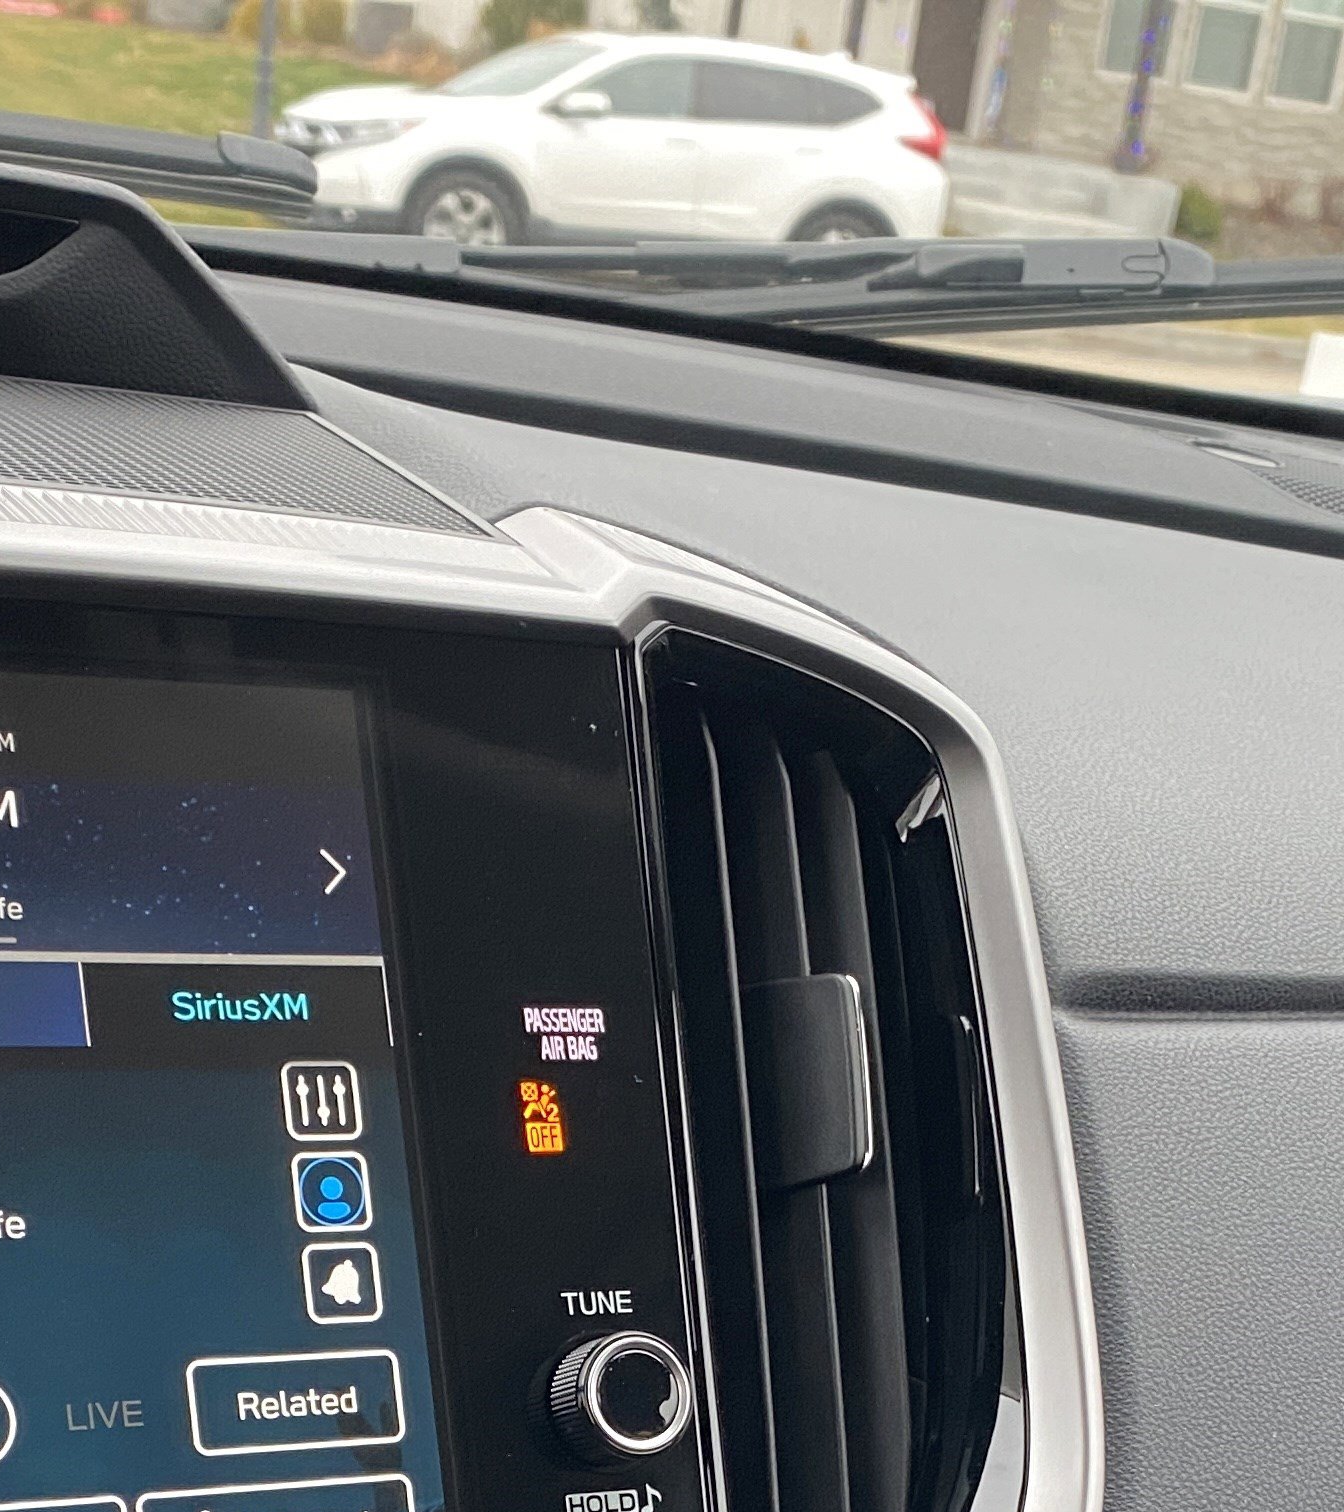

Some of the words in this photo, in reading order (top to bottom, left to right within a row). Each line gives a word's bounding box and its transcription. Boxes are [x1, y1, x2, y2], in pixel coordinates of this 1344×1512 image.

[171, 990, 309, 1021] SiriusXM
[523, 1007, 605, 1033] PASSENGER
[541, 1035, 566, 1060] AIR
[567, 1036, 598, 1060] BAG
[529, 1125, 558, 1150] OFF
[560, 1290, 633, 1316] TUNE
[66, 1400, 145, 1431] LIVE
[237, 1386, 359, 1421] Related
